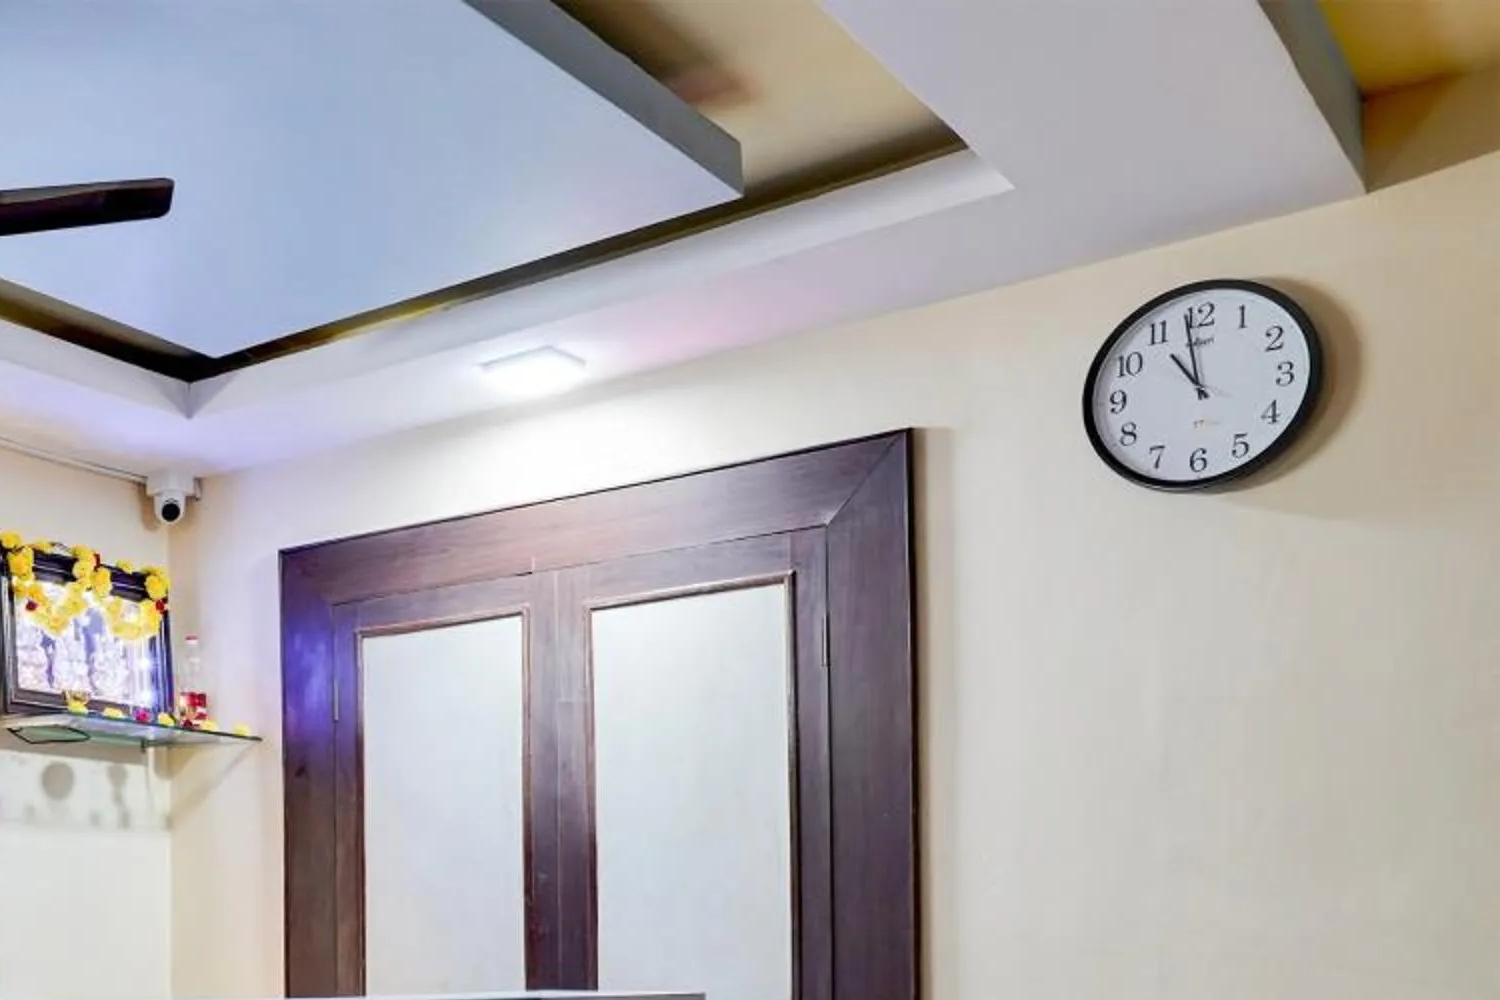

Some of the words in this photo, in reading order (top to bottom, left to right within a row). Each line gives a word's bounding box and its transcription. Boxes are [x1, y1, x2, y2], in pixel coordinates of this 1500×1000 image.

[1187, 302, 1215, 328] 12
[1238, 304, 1249, 329] 1
[1148, 320, 1169, 346] 11
[1265, 325, 1284, 352] 2
[1116, 351, 1144, 378] 10
[1275, 361, 1295, 386] 3
[1109, 390, 1128, 414] 9
[1261, 399, 1280, 424] 4
[1119, 422, 1137, 446] 8
[1231, 433, 1250, 458] 5
[1149, 445, 1166, 469] 7
[1189, 448, 1208, 472] 6
